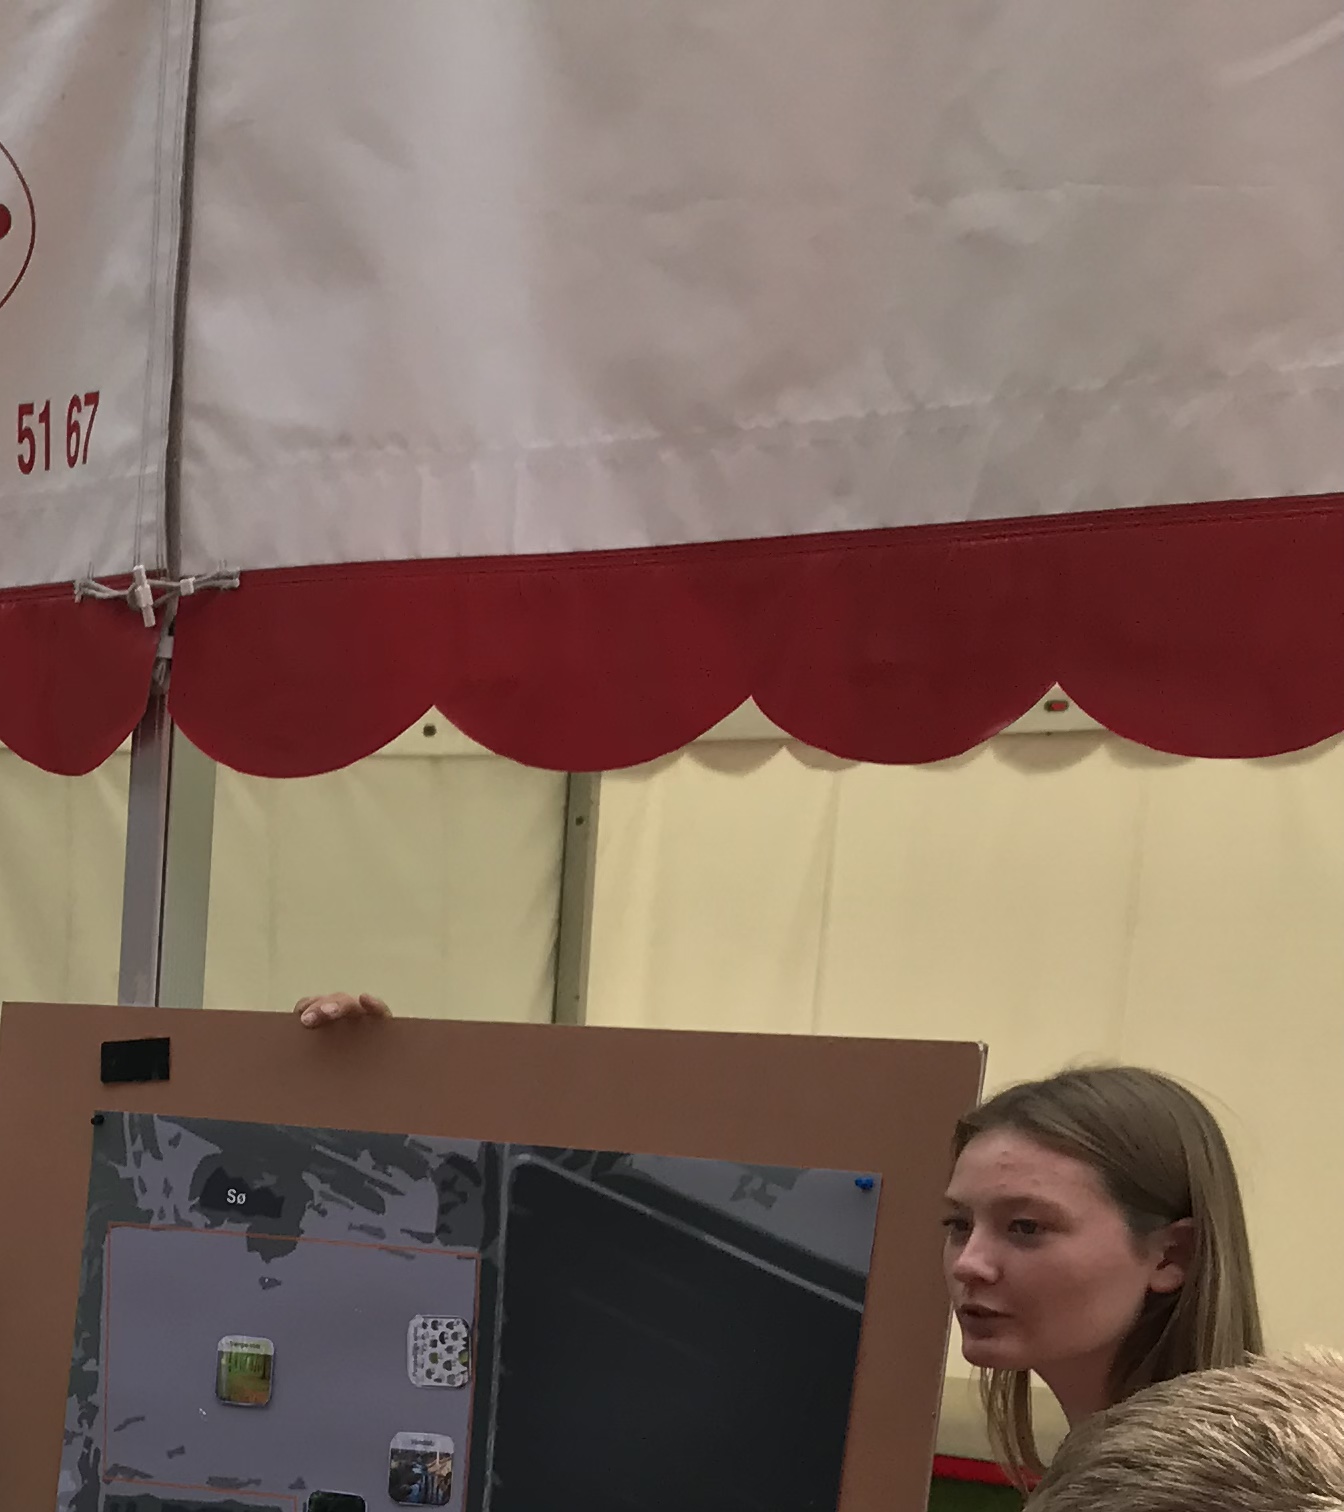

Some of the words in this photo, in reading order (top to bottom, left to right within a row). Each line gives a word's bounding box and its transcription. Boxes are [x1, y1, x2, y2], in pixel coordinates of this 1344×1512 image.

[16, 399, 51, 476] 51
[65, 390, 100, 469] 67
[226, 1188, 247, 1205] Sø
